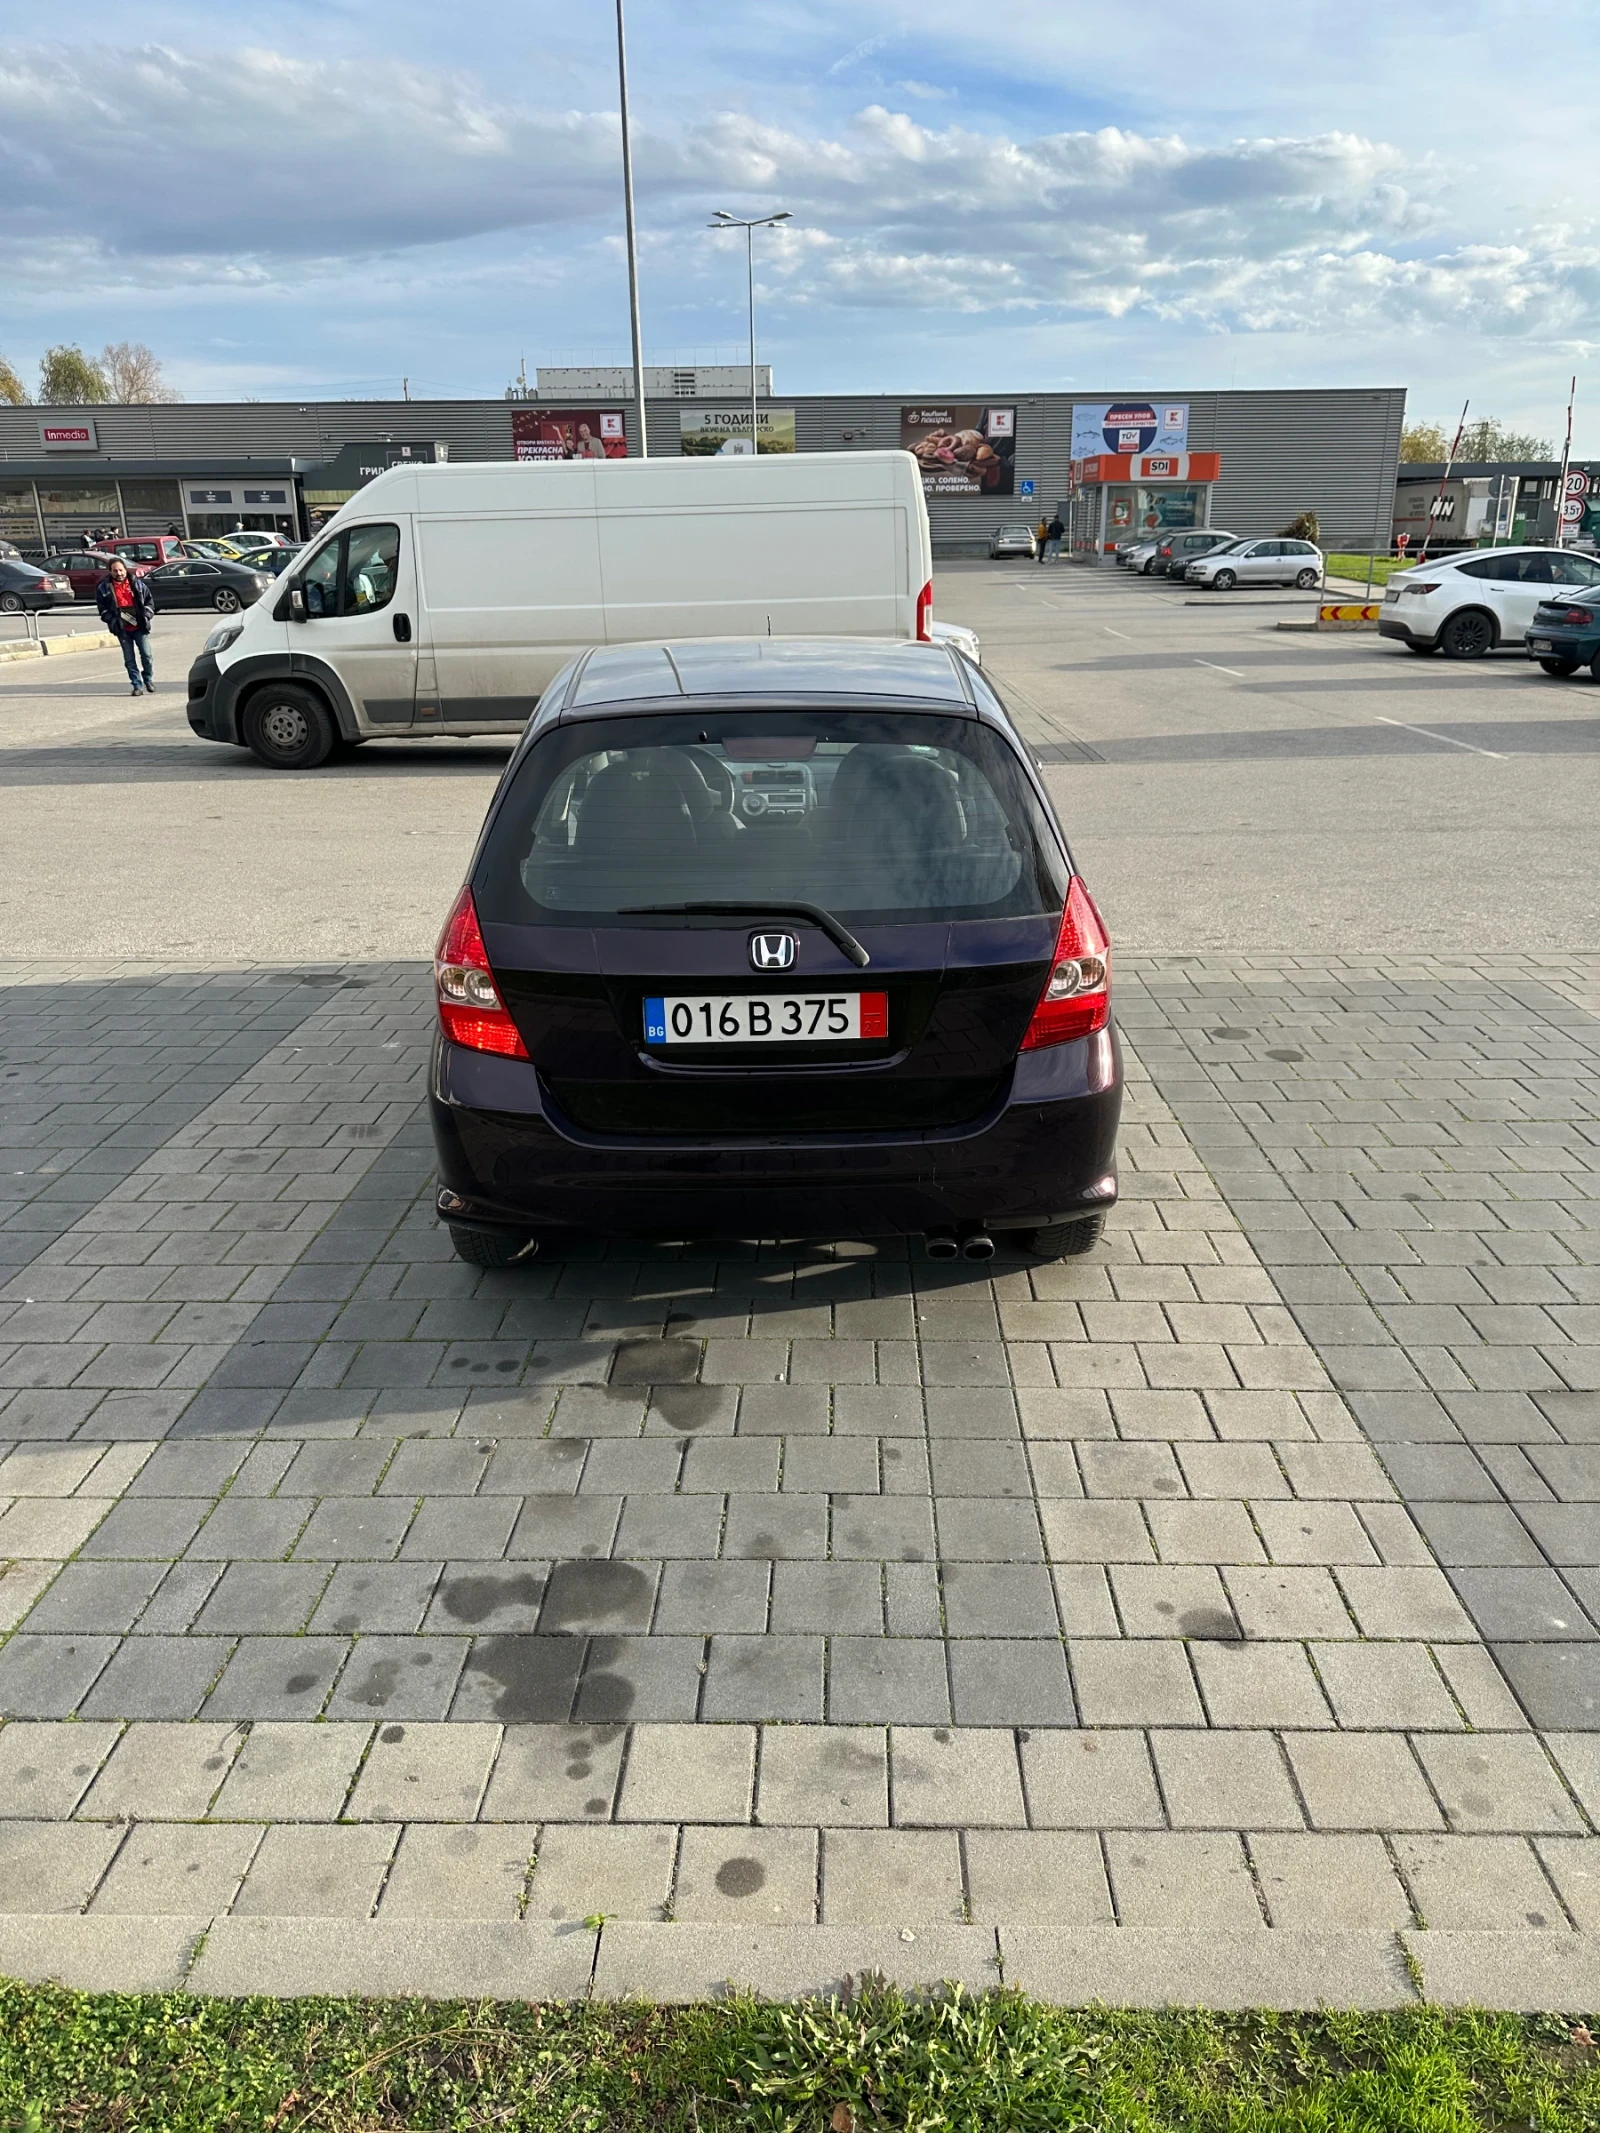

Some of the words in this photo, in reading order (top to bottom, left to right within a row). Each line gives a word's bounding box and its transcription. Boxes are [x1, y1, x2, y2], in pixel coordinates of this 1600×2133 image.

[704, 414, 711, 425] 5
[47, 430, 87, 440] inmedio
[517, 446, 564, 454] ПРЕКРАСНА
[1151, 461, 1168, 471] SDI
[1566, 477, 1582, 490] 20
[648, 1026, 664, 1037] BG
[671, 1002, 740, 1037] 016
[748, 1001, 772, 1036] B
[781, 998, 849, 1035] 375
[864, 1020, 881, 1032] 27
